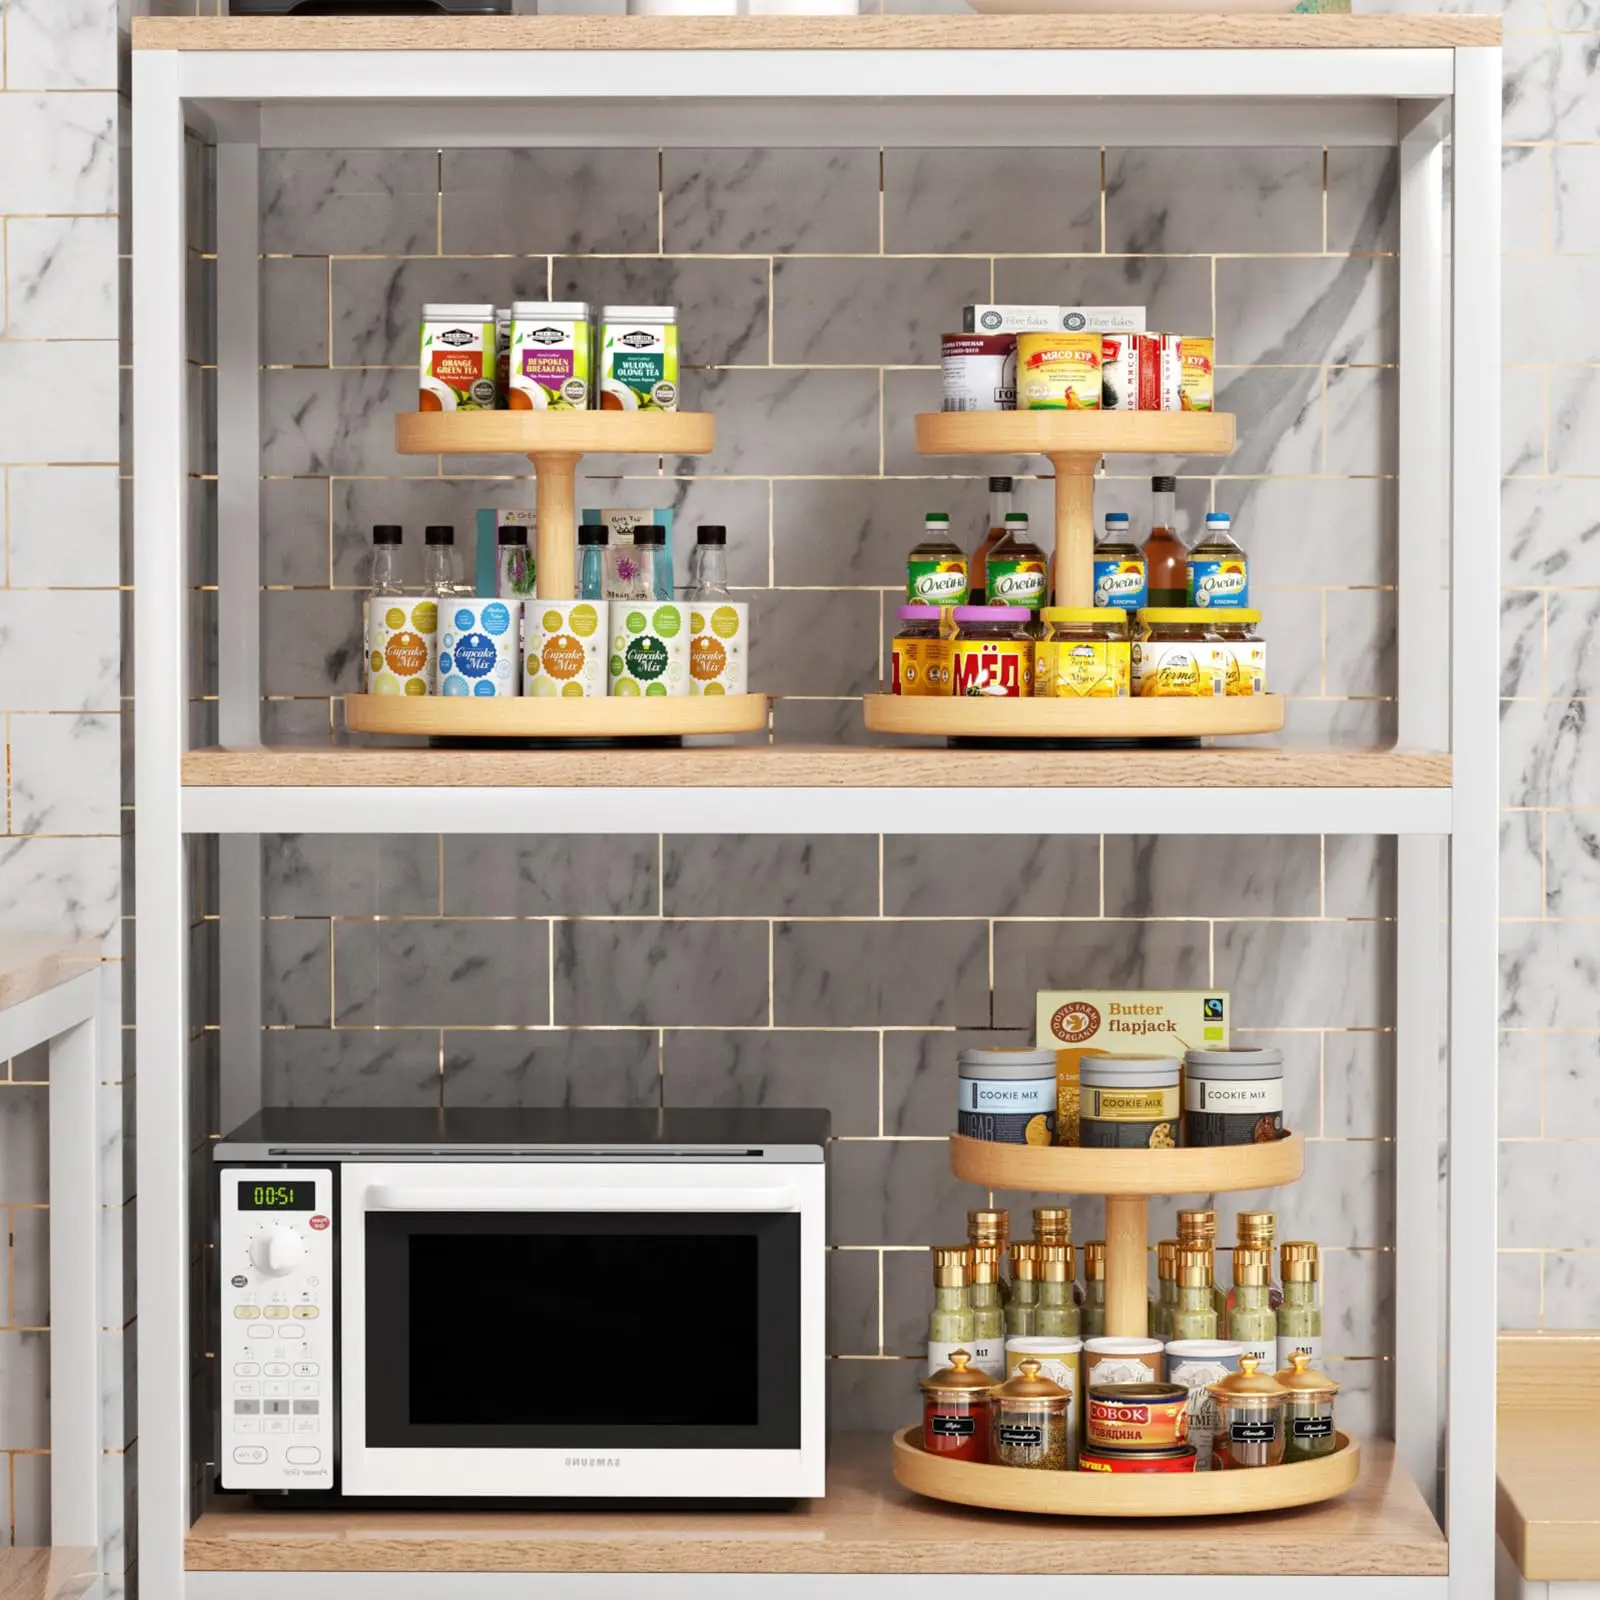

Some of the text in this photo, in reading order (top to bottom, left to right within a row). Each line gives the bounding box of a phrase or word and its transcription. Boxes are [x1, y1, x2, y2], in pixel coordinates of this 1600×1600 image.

[1041, 350, 1073, 361] МЯСО
[1074, 350, 1092, 361] КУР
[1187, 356, 1204, 365] КУР
[442, 359, 472, 367] ORANGE
[526, 365, 569, 373] BREAKFAST
[622, 361, 655, 369] WULONG
[436, 366, 478, 375] GREEN TEA
[645, 369, 660, 377] TEA
[920, 576, 965, 595] Олейна
[1000, 576, 1044, 594] Олейна
[1102, 576, 1142, 592] Олейна
[1203, 576, 1243, 592] Олейна
[387, 646, 425, 659] Cupcake
[456, 646, 494, 660] Cupcake
[543, 648, 582, 662] Cupcake
[627, 649, 666, 662] Cupcake
[692, 650, 724, 662] upcake
[399, 656, 420, 667] Mix
[468, 657, 490, 669] Mix
[556, 660, 577, 671] Mix
[639, 660, 661, 672] Mix
[697, 660, 719, 672] Mix
[952, 643, 1020, 697] МЁД
[1158, 667, 1197, 681] Ferma
[1075, 1004, 1097, 1020] FARM
[1108, 1002, 1163, 1016] Butter
[1058, 1022, 1097, 1041] ORGANIC
[1108, 1019, 1177, 1035] flapjack
[979, 1090, 1039, 1100] COOKIE MIX
[1207, 1091, 1247, 1100] COOKIE
[1102, 1099, 1162, 1108] COOKIE MIX
